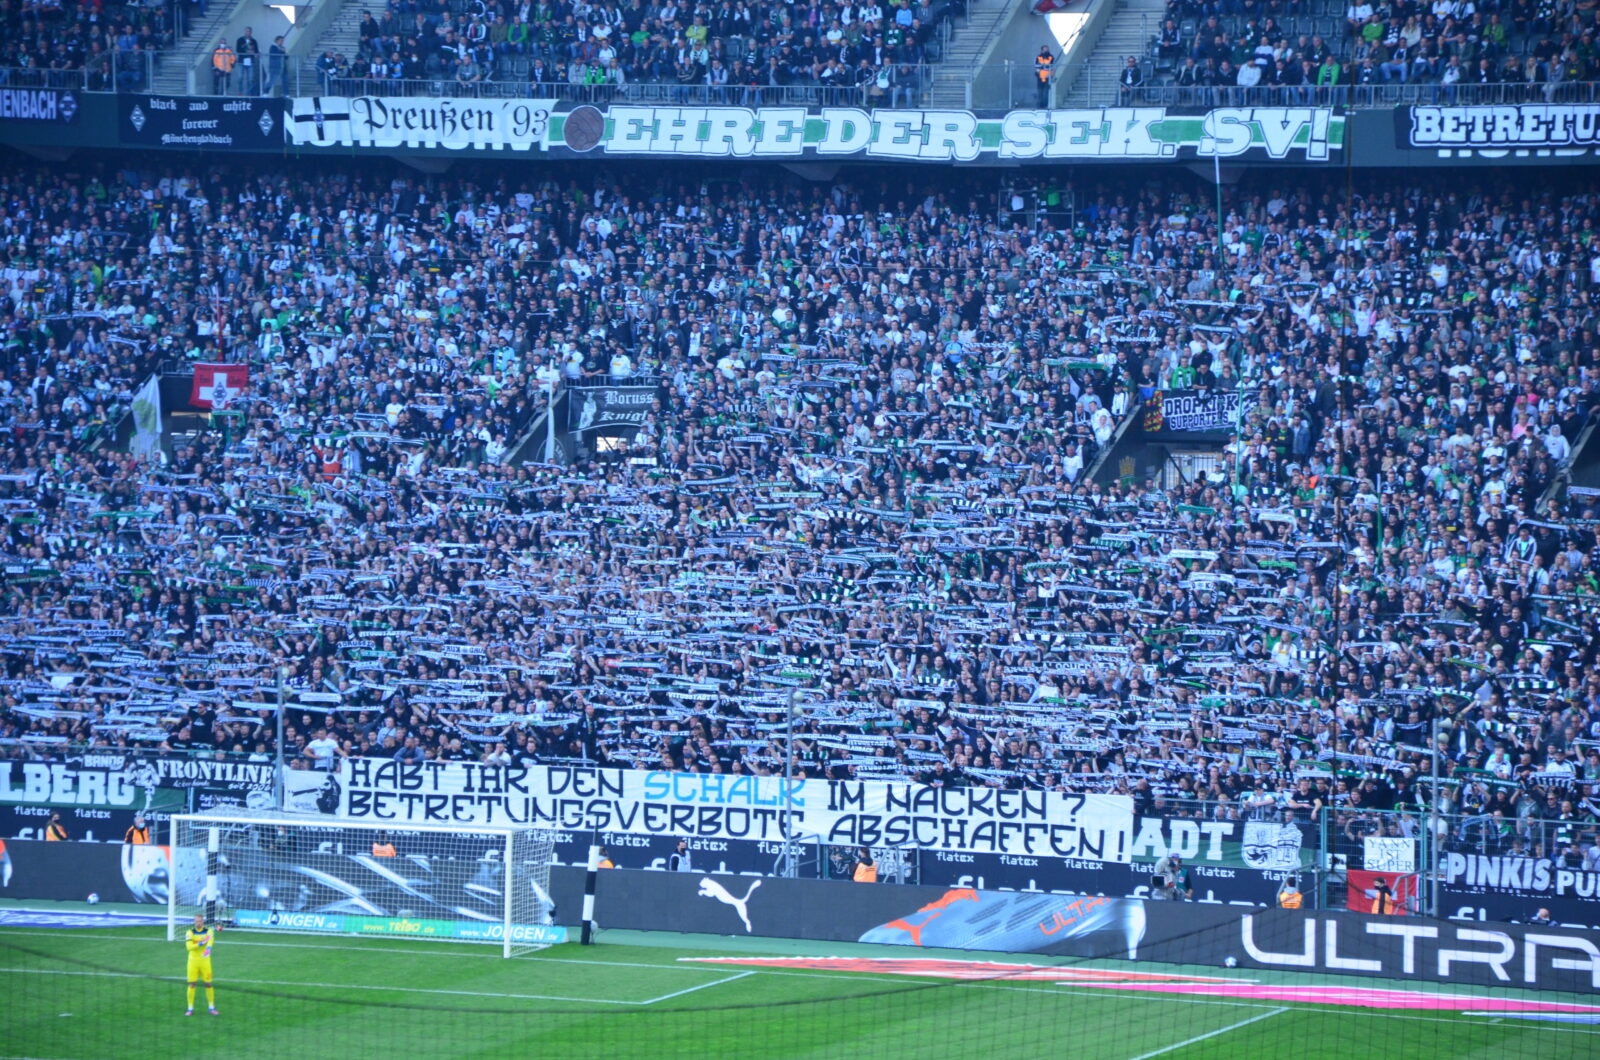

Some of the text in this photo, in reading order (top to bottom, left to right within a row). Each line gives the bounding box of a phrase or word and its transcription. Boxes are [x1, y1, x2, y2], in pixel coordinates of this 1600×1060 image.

[0, 90, 56, 119] ENBACH
[352, 97, 494, 137] Preußen
[1411, 104, 1600, 147] BETRETU
[604, 105, 808, 157] EHRE
[817, 107, 981, 160] DER
[998, 106, 1179, 158] SEK.
[1197, 106, 1333, 160] SV!
[1170, 411, 1229, 430] SUPPORTES
[156, 759, 273, 785] FRONTLINE
[349, 758, 446, 791] HABT
[463, 764, 529, 794] IHR
[547, 766, 624, 798] DEN
[644, 771, 805, 807] SCHALK
[827, 780, 865, 812] IM
[886, 781, 1047, 820] NACKEN
[14, 806, 51, 816] flatex
[74, 808, 111, 819] flatex
[135, 810, 170, 821] fatex
[348, 790, 804, 840] BETRETUNGSVERBOTE
[602, 833, 650, 848] flatex
[936, 851, 974, 863] flatex
[1000, 855, 1038, 867] flatex
[1064, 858, 1103, 870] flatex
[1130, 863, 1157, 873] flat
[1195, 866, 1235, 878] flatex
[1556, 870, 1600, 897] PU
